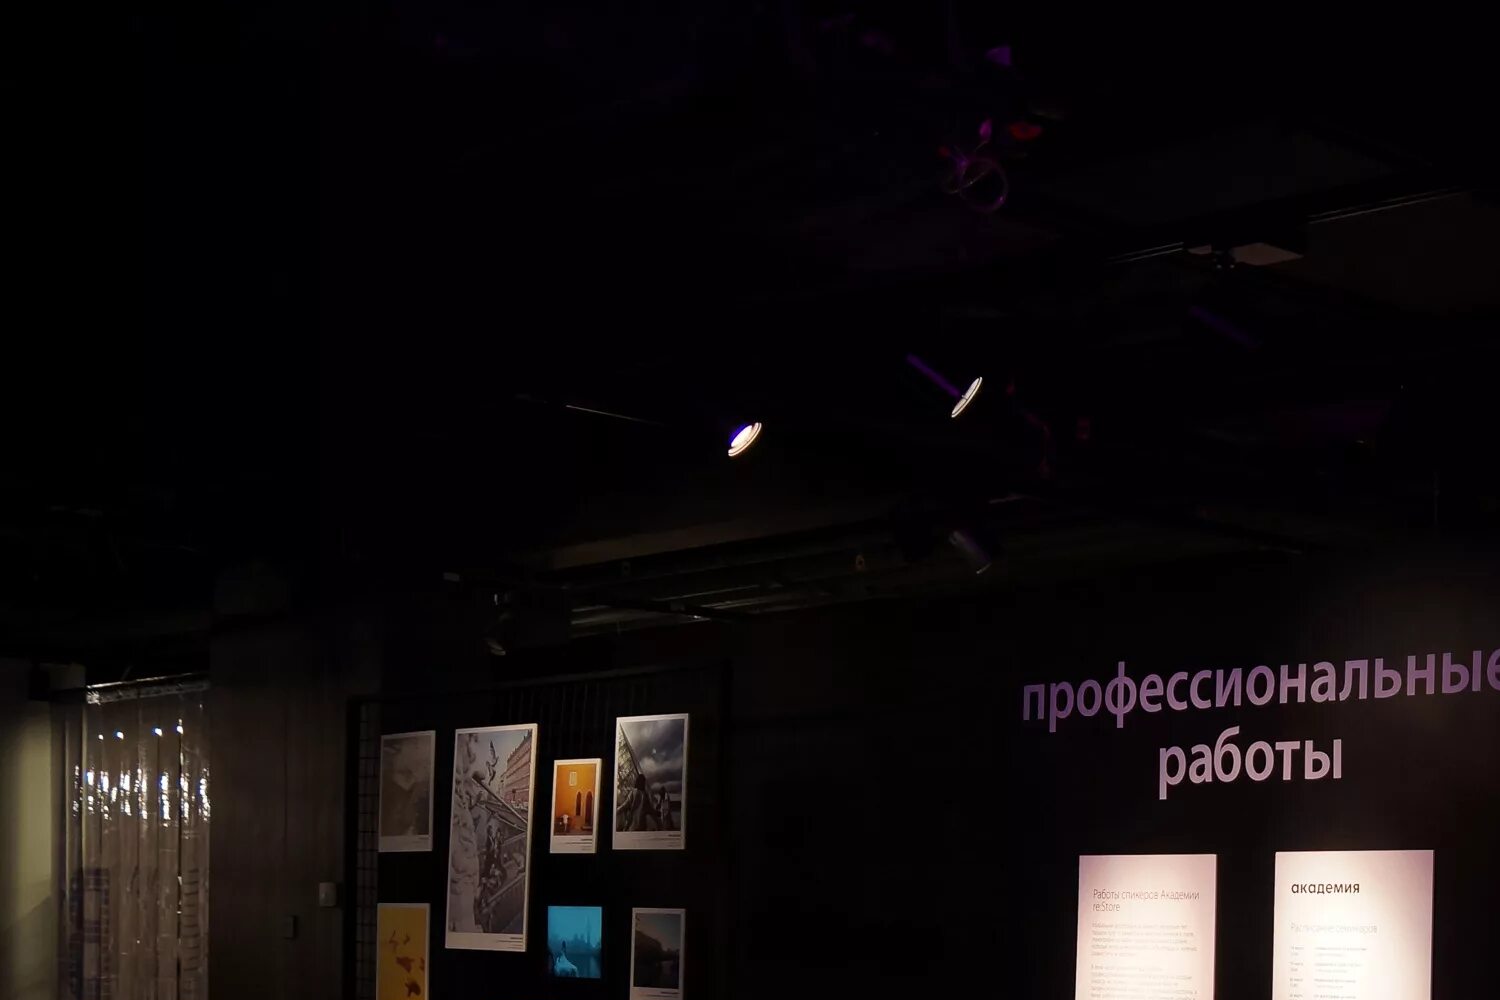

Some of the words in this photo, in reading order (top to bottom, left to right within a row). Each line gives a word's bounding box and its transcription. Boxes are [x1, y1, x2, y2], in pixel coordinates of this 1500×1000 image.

[1158, 725, 1343, 800] работы
[1093, 888, 1120, 900] Работы
[1121, 890, 1159, 902] спикеров
[1160, 889, 1200, 901] Академии
[1290, 882, 1360, 895] академия
